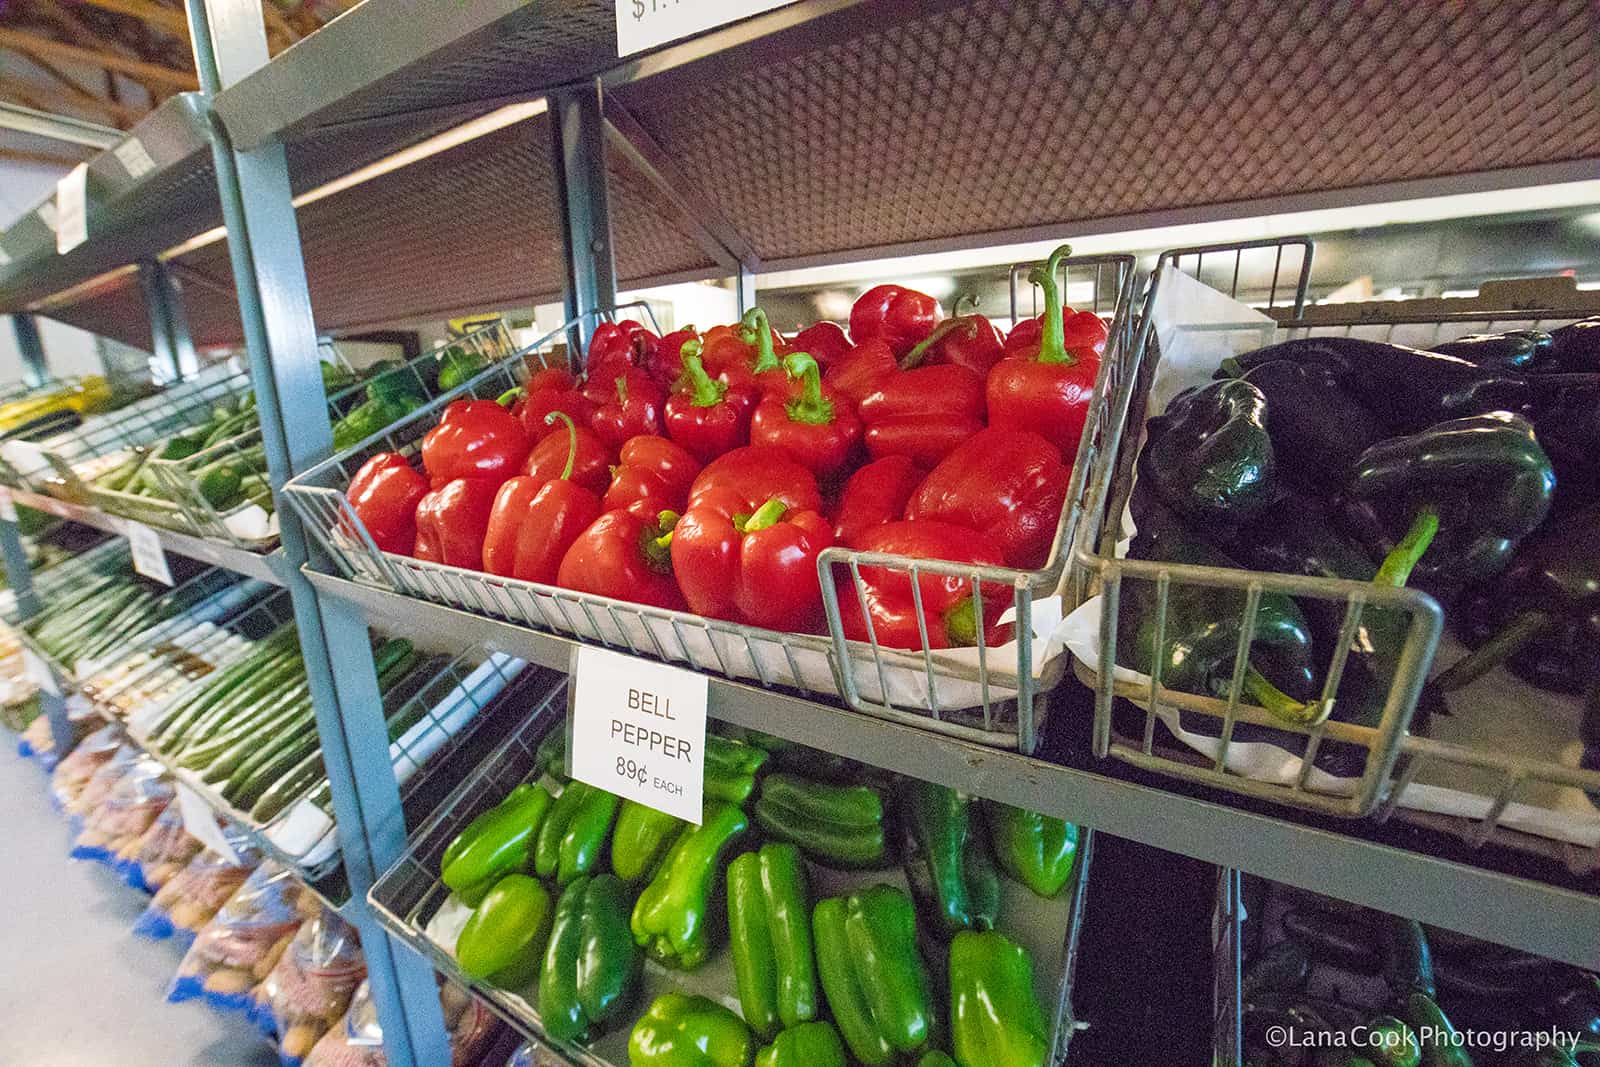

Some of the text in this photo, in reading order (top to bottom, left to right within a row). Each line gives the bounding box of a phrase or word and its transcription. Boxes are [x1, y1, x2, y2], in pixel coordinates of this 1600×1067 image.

[628, 688, 676, 720] BELL
[611, 719, 692, 763] PEPPER
[616, 756, 683, 797] 89¢ EACH
